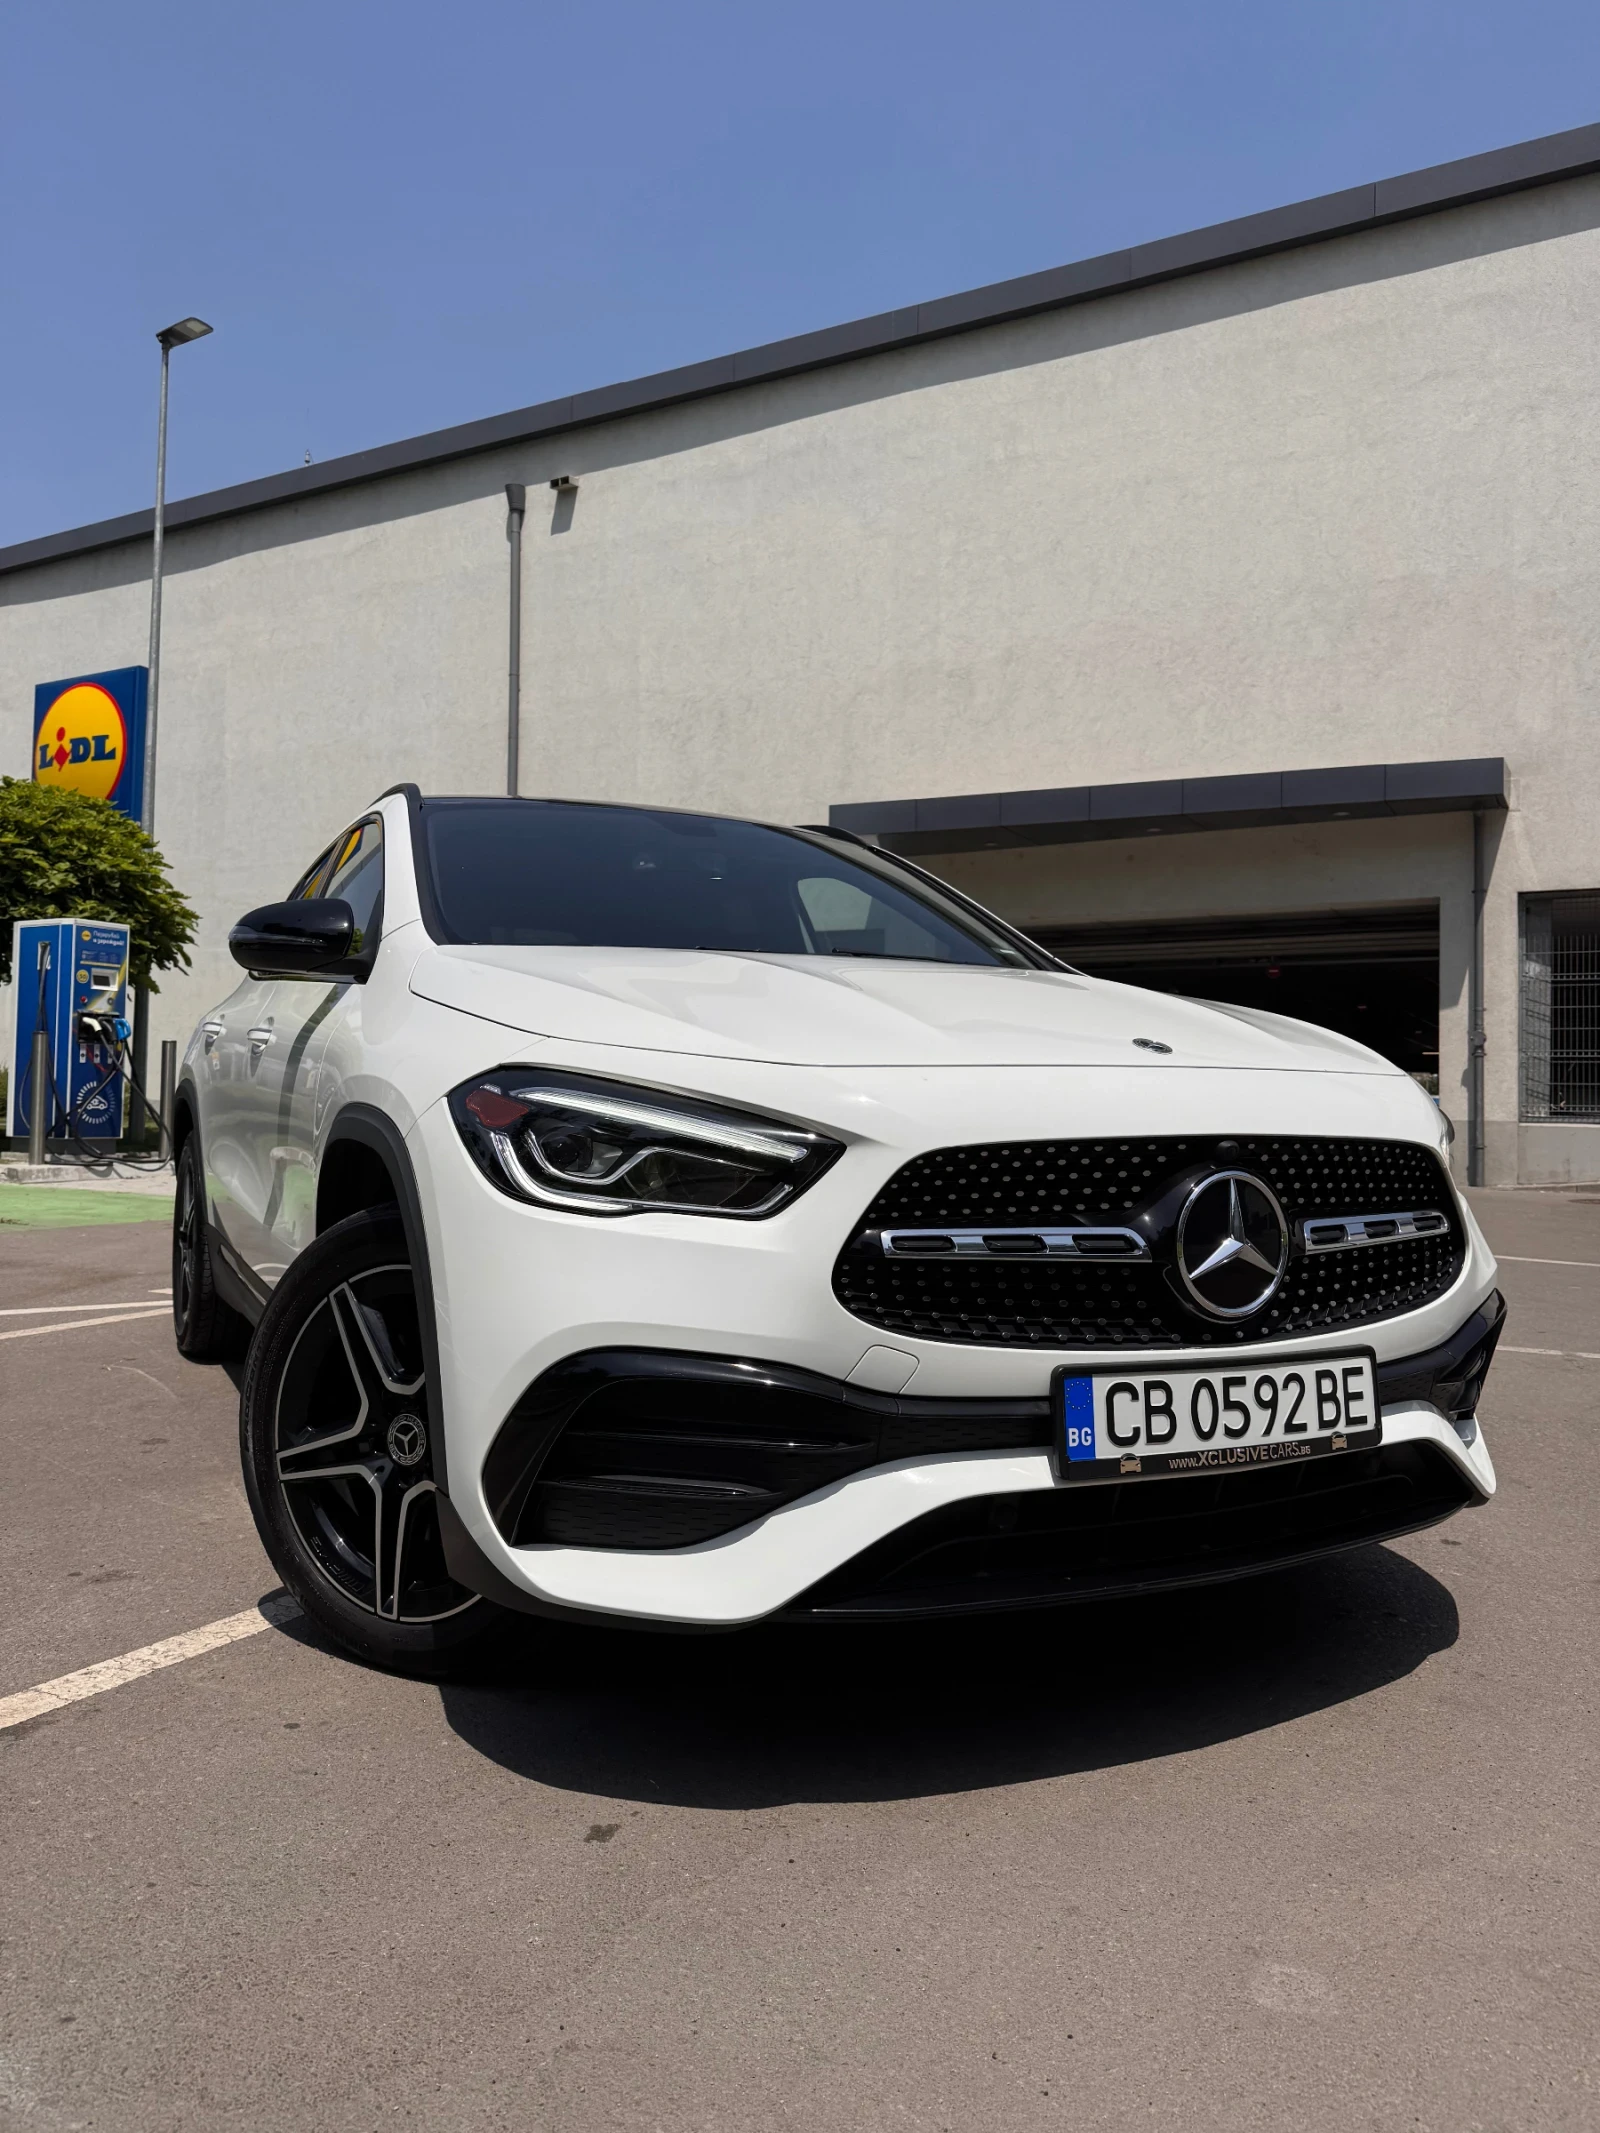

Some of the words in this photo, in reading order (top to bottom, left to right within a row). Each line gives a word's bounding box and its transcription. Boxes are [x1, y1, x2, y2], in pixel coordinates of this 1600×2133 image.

[1105, 1379, 1178, 1447] CB
[1190, 1372, 1308, 1441] 0592
[1314, 1366, 1368, 1431] BE
[1068, 1427, 1092, 1447] BG
